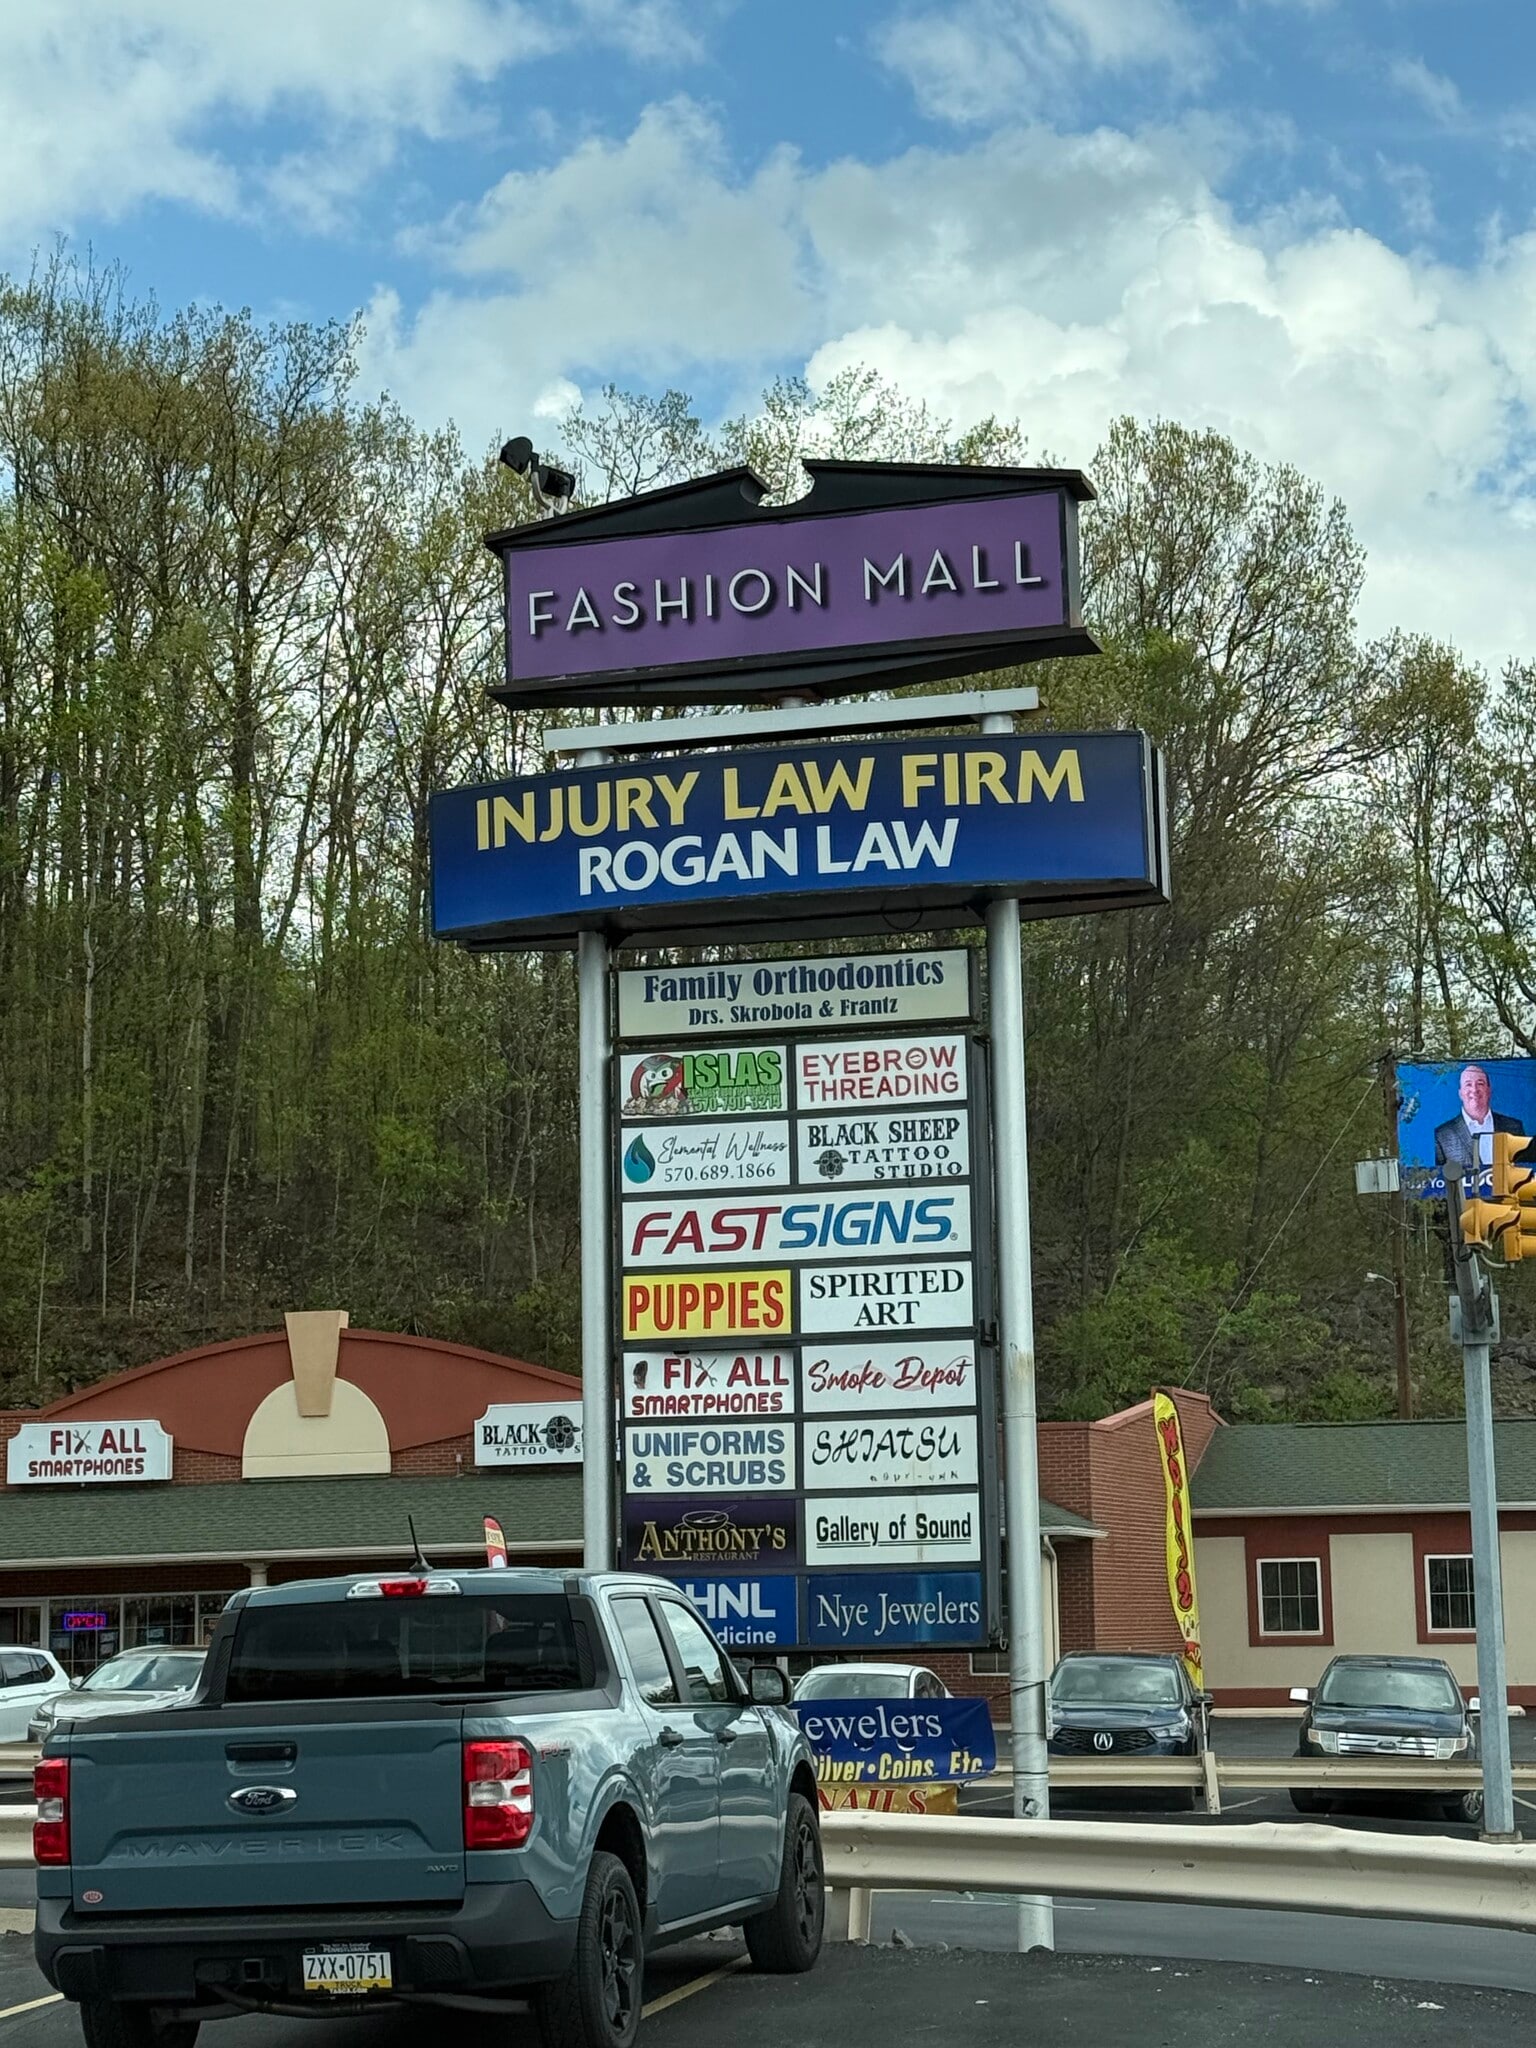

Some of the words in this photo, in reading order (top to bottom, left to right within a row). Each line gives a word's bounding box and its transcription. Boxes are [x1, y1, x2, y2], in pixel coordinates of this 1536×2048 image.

[528, 560, 823, 636] FASHION
[863, 540, 1043, 602] MALL
[475, 770, 701, 852] INJURY
[722, 757, 876, 821] LAW
[901, 749, 1086, 809] FIRM
[578, 826, 800, 897] ROGAN
[816, 817, 960, 875] LAW
[643, 970, 743, 1004] Family
[752, 957, 945, 997] Orthodontics
[688, 1007, 725, 1027] Drs.
[730, 1001, 813, 1024] Skrobola
[818, 999, 834, 1018] &
[840, 995, 899, 1017] Frantz
[682, 1050, 783, 1090] ISLAS
[802, 1045, 958, 1078] EYEBROW
[803, 1070, 960, 1103] THREADING
[657, 1132, 721, 1165] Elemental
[725, 1130, 789, 1161] Wellness
[807, 1121, 880, 1148] BLACK
[888, 1117, 961, 1144] SHEEP
[848, 1144, 951, 1165] TATTOO
[873, 1161, 963, 1180] STUDIO
[663, 1161, 777, 1184] 570.689.1866
[809, 1268, 965, 1300] SPIRITED
[628, 1279, 785, 1333] PUPPIES
[853, 1300, 921, 1327] ART
[663, 1356, 718, 1390] FIX
[726, 1354, 790, 1388] ALL
[807, 1359, 887, 1394] Smoke
[892, 1355, 974, 1395] Depot
[631, 1391, 784, 1417] SMARTPHONES
[50, 1429, 92, 1456] FIX
[98, 1427, 147, 1455] ALL
[482, 1423, 541, 1446] BLACK
[631, 1429, 786, 1458] UNIFORMS
[811, 1425, 962, 1466] SHIATSU
[28, 1457, 145, 1478] SMARTPHONES
[495, 1446, 548, 1457] TATTOO
[632, 1461, 652, 1488] &
[666, 1459, 787, 1487] SCRUBS
[633, 1521, 787, 1562] ANTHONY'S
[816, 1515, 880, 1547] Gallery
[888, 1513, 907, 1540] of
[915, 1511, 972, 1539] Sound
[692, 1551, 761, 1562] RESTAURANT
[816, 1593, 869, 1637] Nye
[873, 1591, 980, 1636] Jewelers
[244, 1790, 274, 1806] Ford
[123, 1834, 405, 1858] MAVERICK
